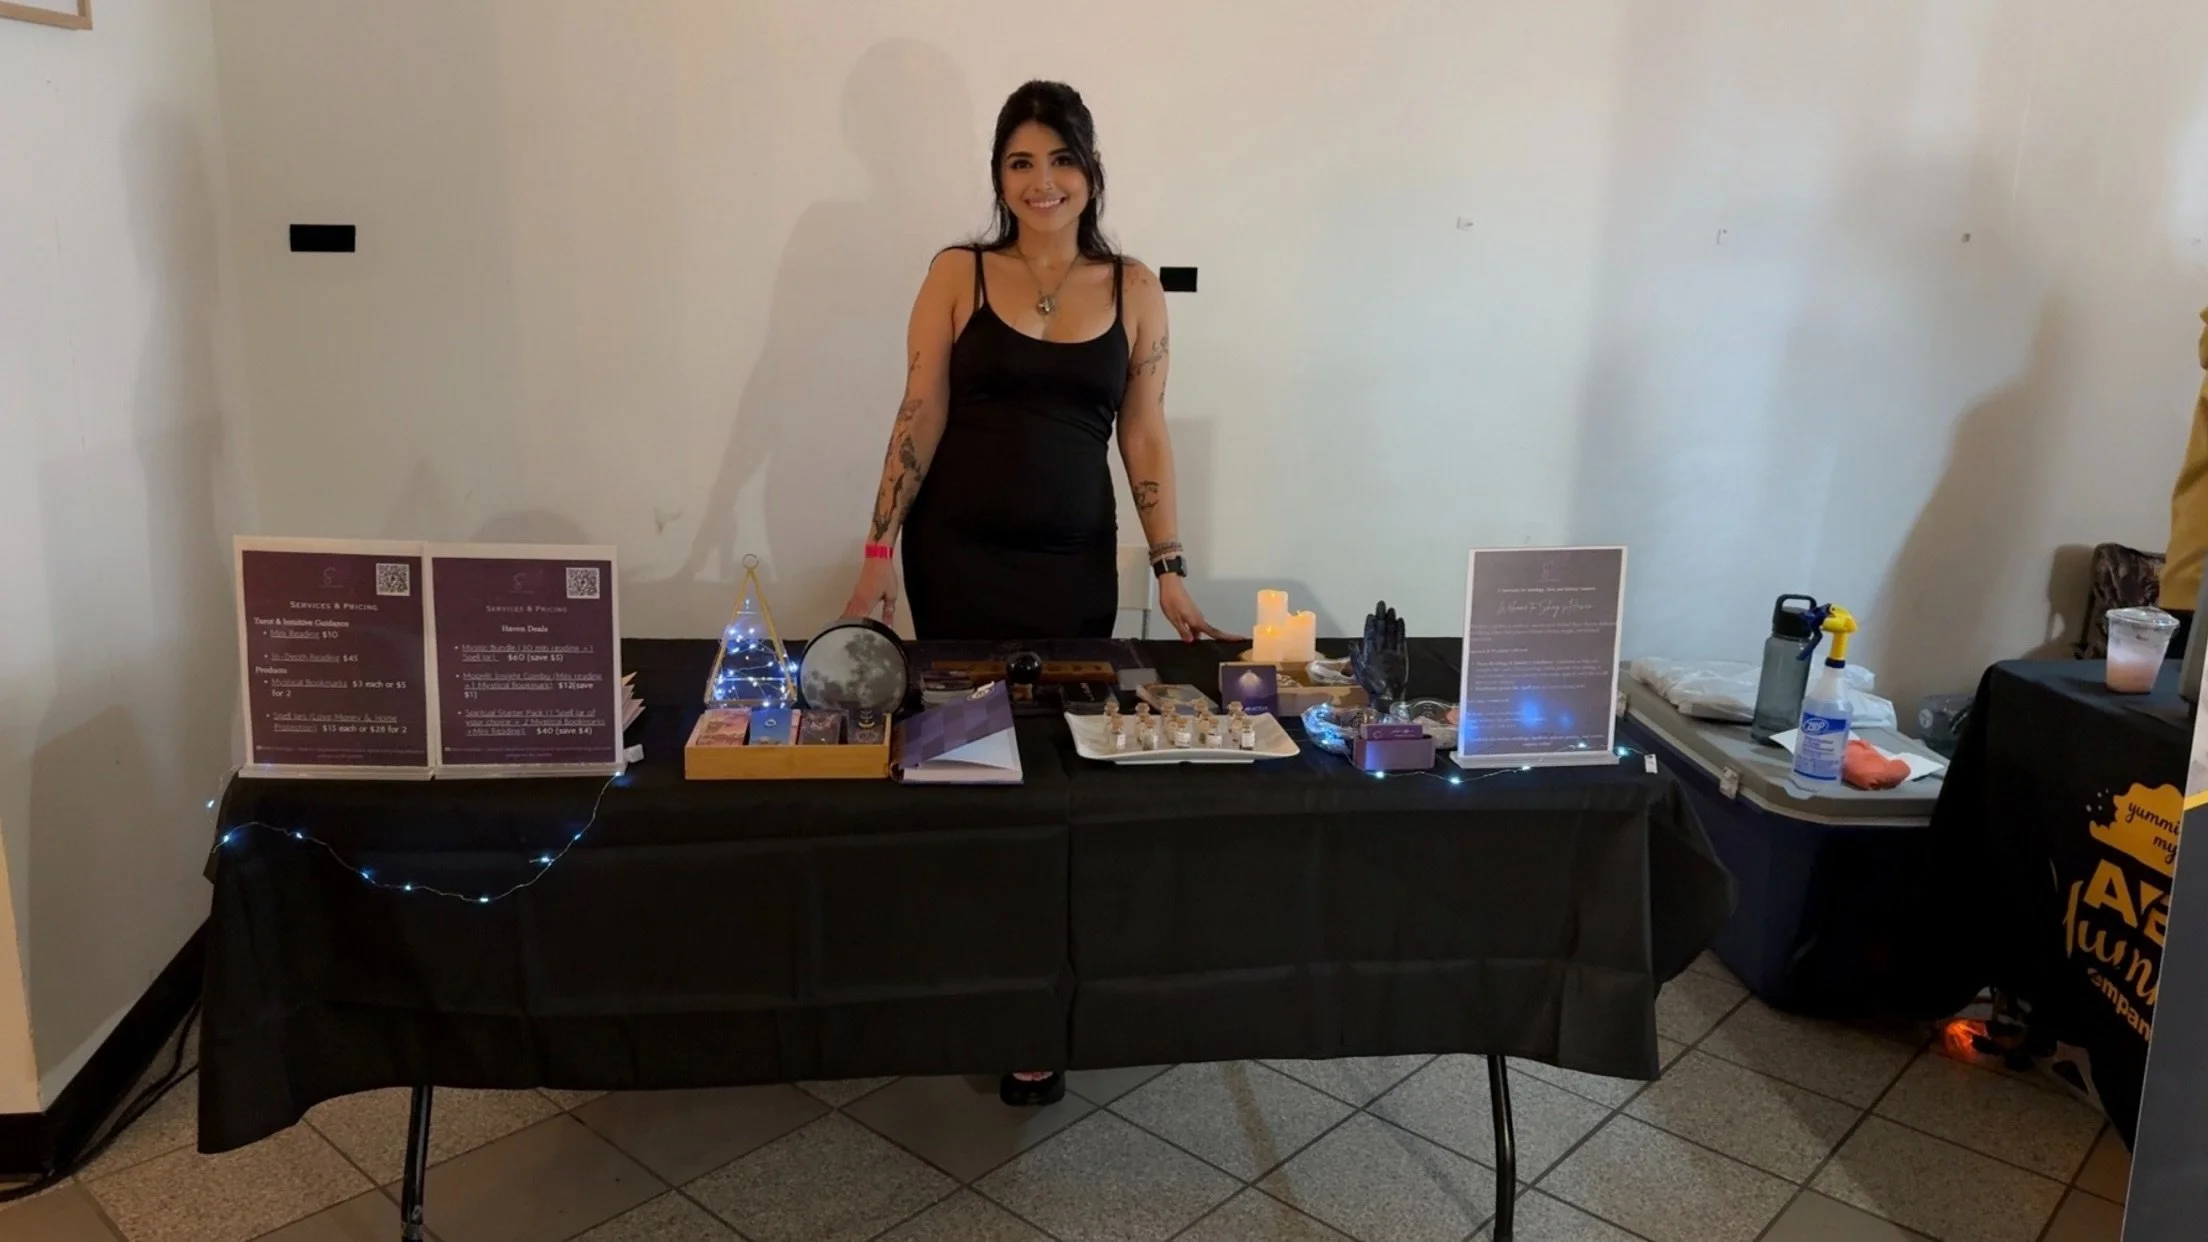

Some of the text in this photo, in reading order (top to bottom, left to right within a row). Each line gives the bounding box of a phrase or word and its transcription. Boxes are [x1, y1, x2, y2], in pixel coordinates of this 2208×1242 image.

[333, 602, 341, 610] &
[275, 618, 282, 626] &
[314, 619, 350, 628] Guidance
[255, 666, 288, 675] Products
[364, 680, 384, 689] each
[384, 682, 394, 690] or
[271, 688, 284, 697] for
[338, 725, 357, 734] each
[388, 725, 400, 734] for
